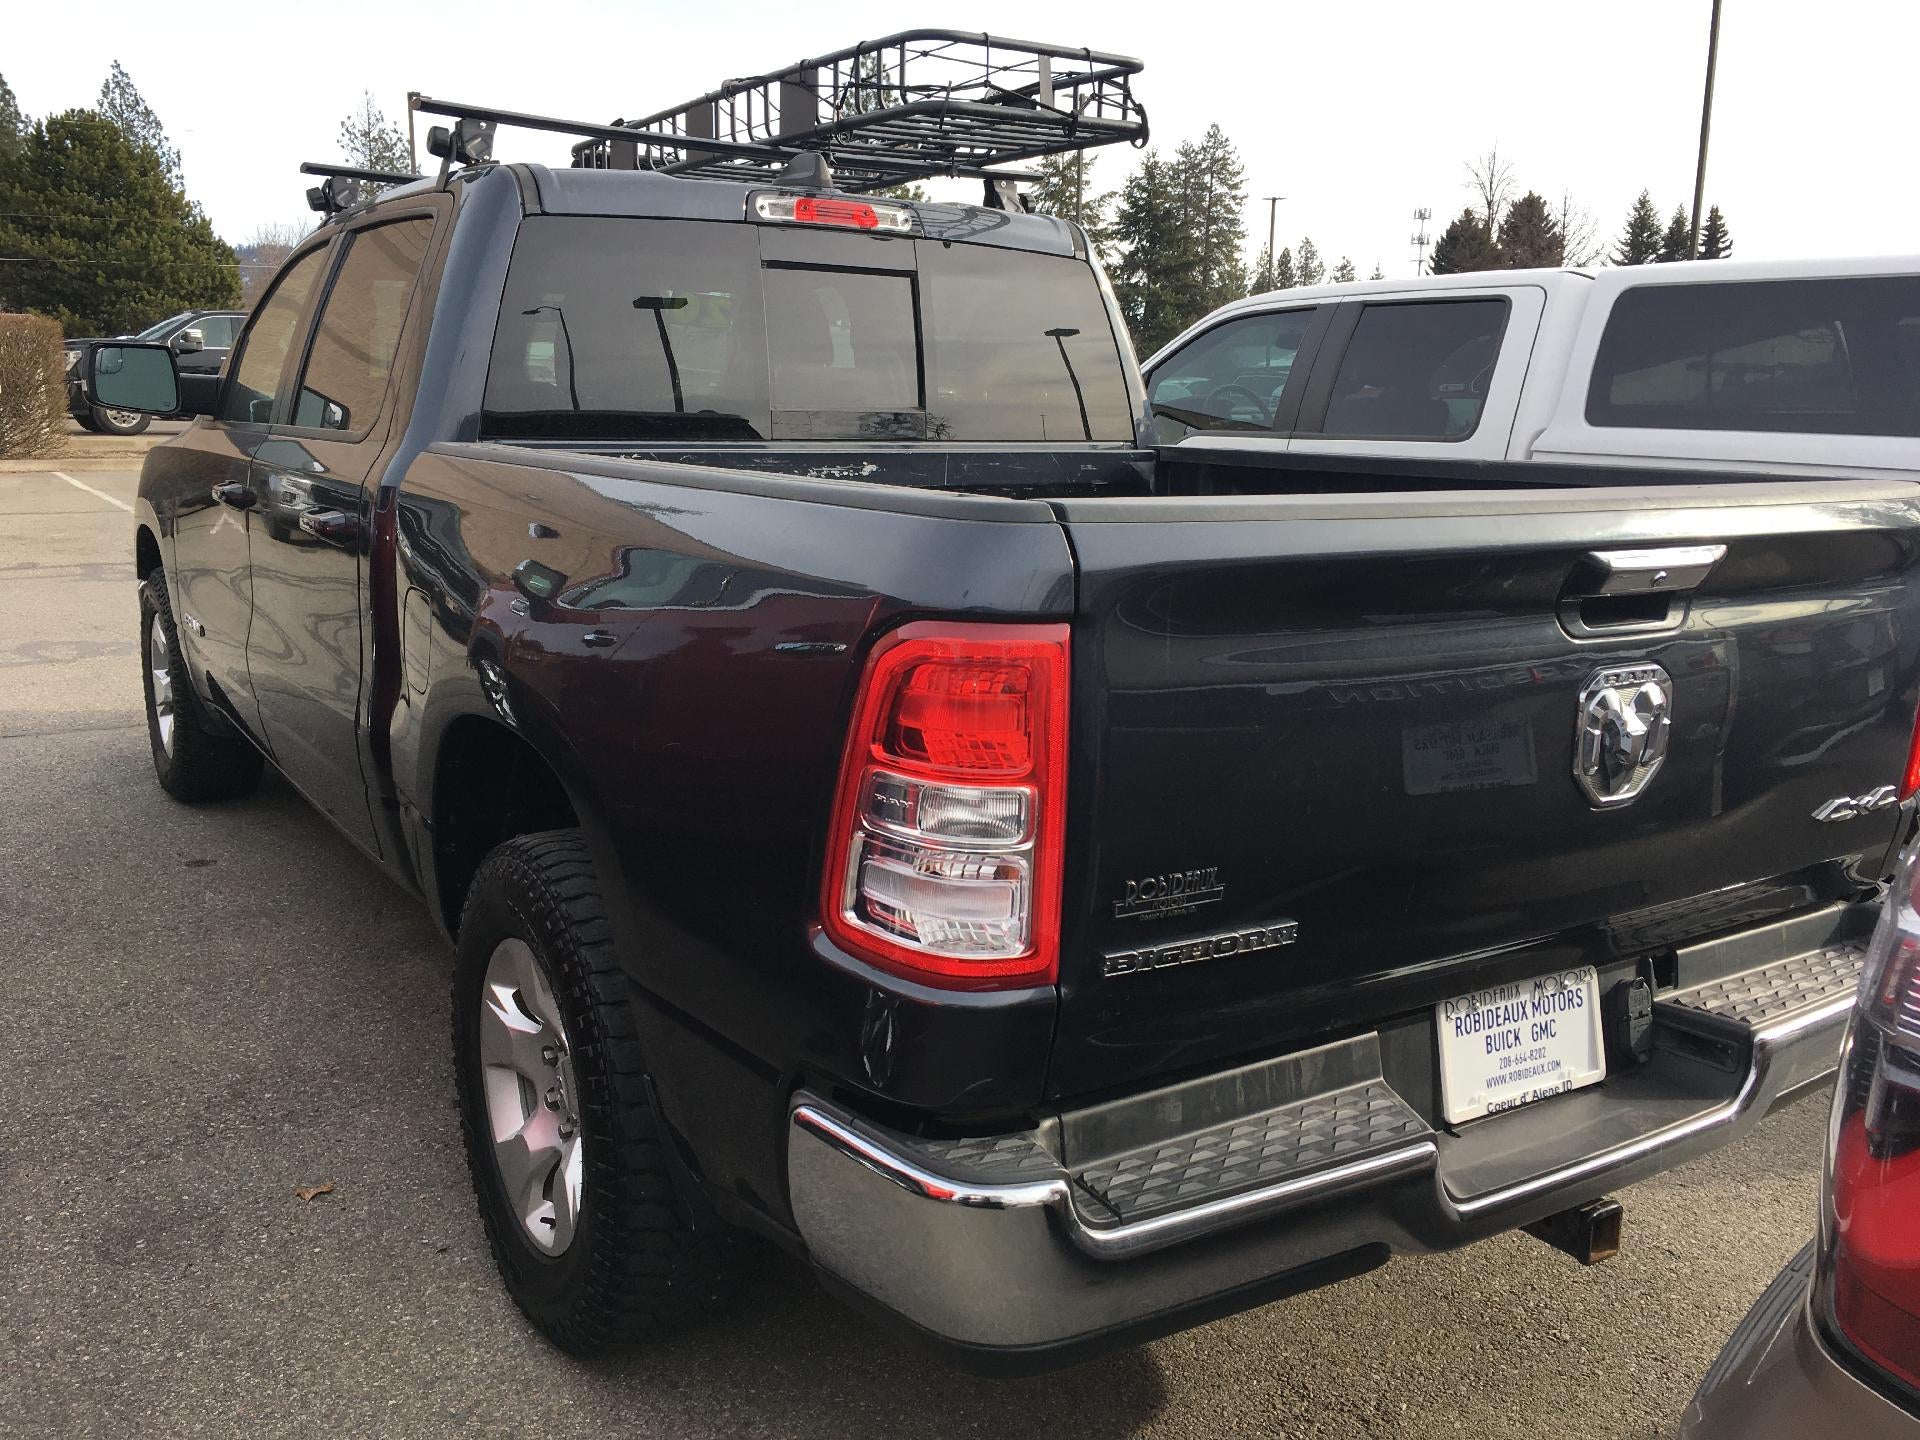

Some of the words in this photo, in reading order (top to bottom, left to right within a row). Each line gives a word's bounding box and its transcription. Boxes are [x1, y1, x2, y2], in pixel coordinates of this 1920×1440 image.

[1445, 984, 1520, 1022] ROBIDEAUX
[1533, 967, 1594, 1002] MOTORS
[1455, 1000, 1529, 1038] ROBIDEAUX
[1531, 987, 1584, 1018] MOTORS
[1485, 1027, 1521, 1055] BUICK
[1531, 1018, 1557, 1042] GMC
[1486, 1059, 1562, 1089] WWW.ROBIDEAUX.COM
[1487, 1097, 1517, 1114] Coeur
[1532, 1084, 1560, 1101] Alene
[1562, 1078, 1573, 1093] ID
